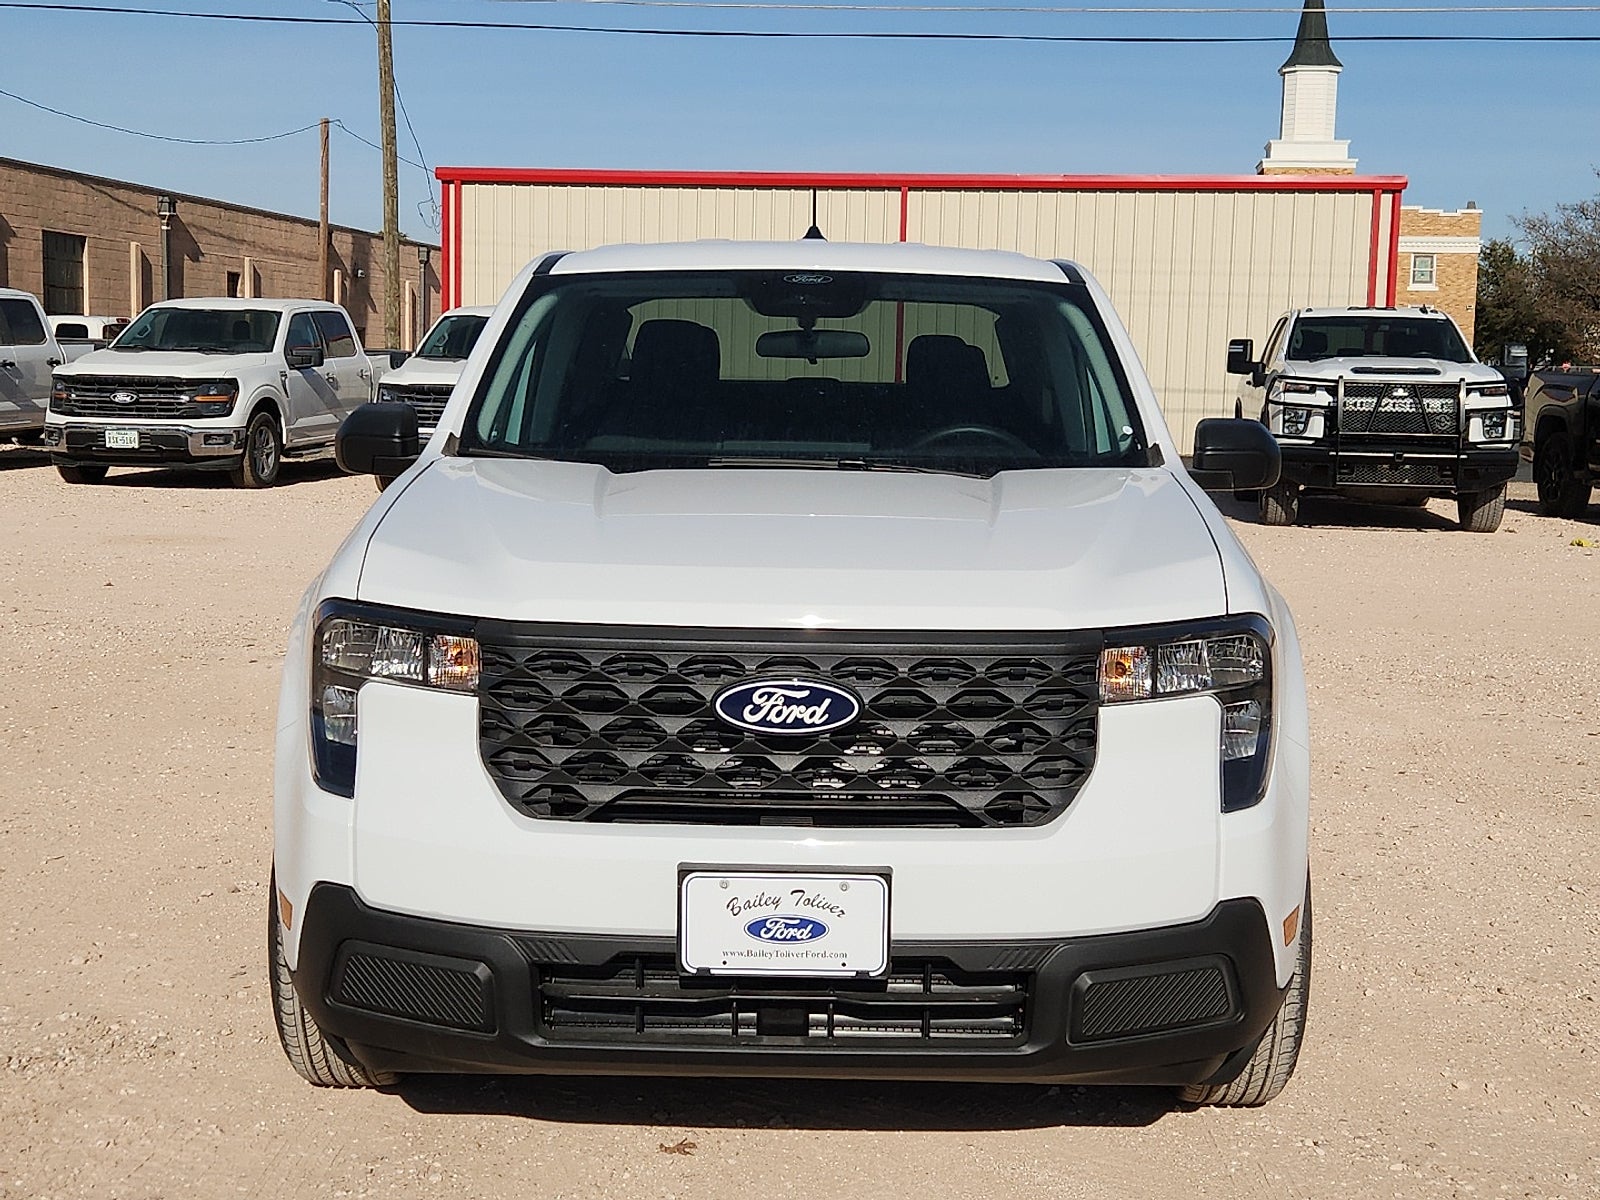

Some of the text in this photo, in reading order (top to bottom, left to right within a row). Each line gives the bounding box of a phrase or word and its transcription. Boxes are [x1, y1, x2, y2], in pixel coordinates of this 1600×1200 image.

[792, 275, 825, 284] Ford
[743, 687, 832, 725] Ford
[726, 889, 846, 919] Bailey Toliver
[760, 917, 813, 941] Ford
[722, 948, 848, 960] www.BaileyToliverFord.com
